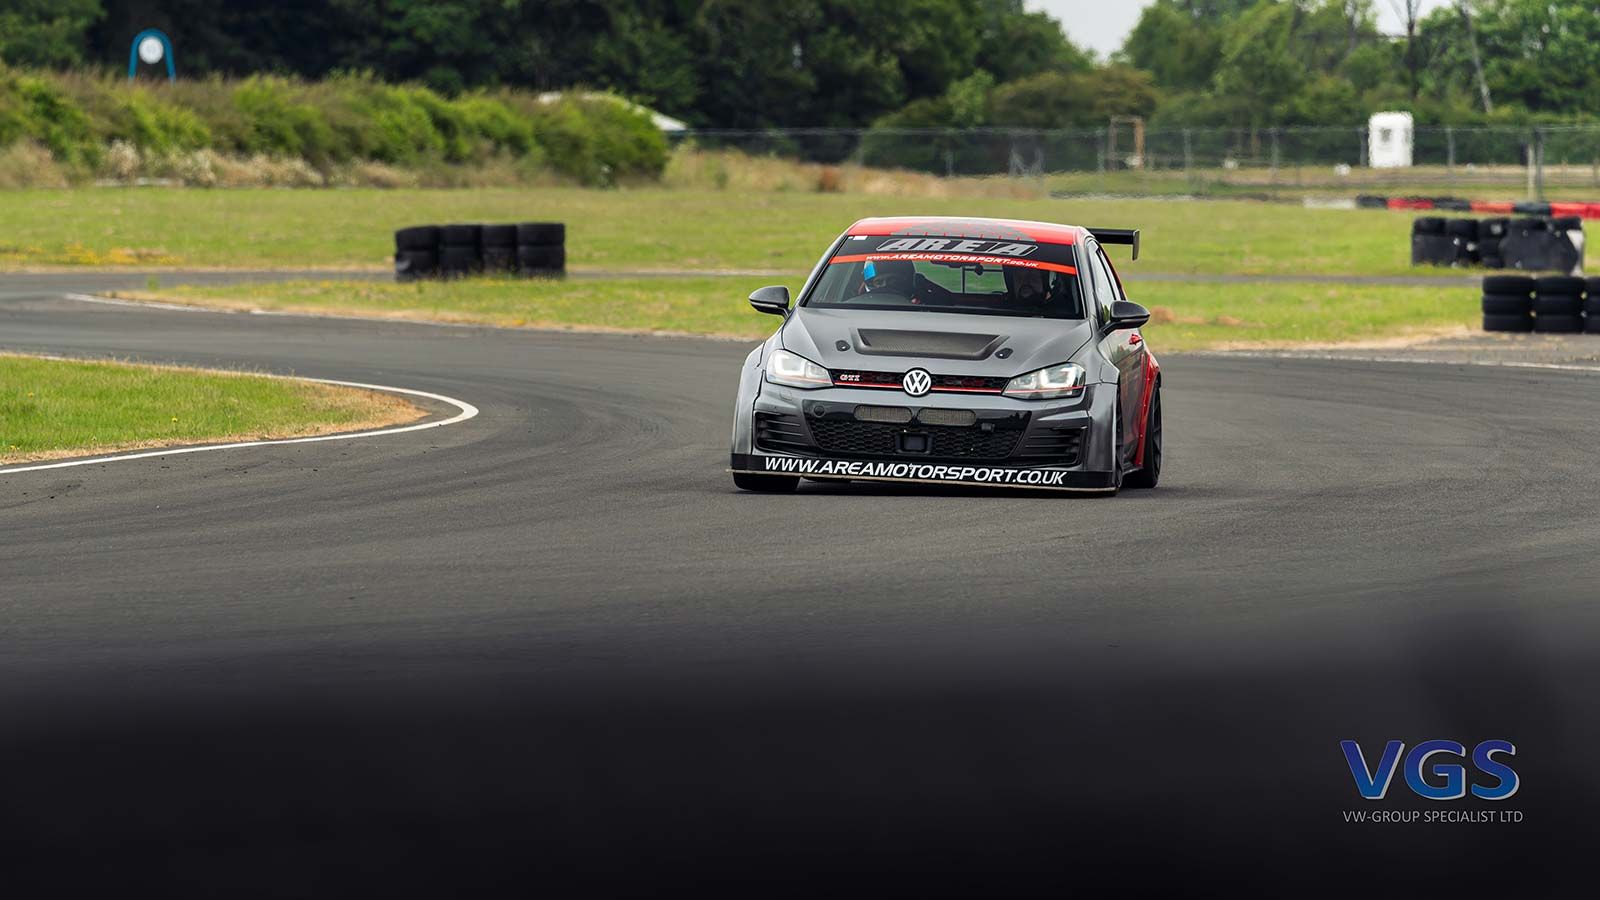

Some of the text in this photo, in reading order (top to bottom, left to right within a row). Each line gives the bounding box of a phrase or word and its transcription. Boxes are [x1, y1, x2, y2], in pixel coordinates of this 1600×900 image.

[876, 238, 1036, 257] AREA
[839, 374, 861, 382] GTI
[765, 457, 1067, 485] WWW.AREAMOTORSPORT.CO.UK
